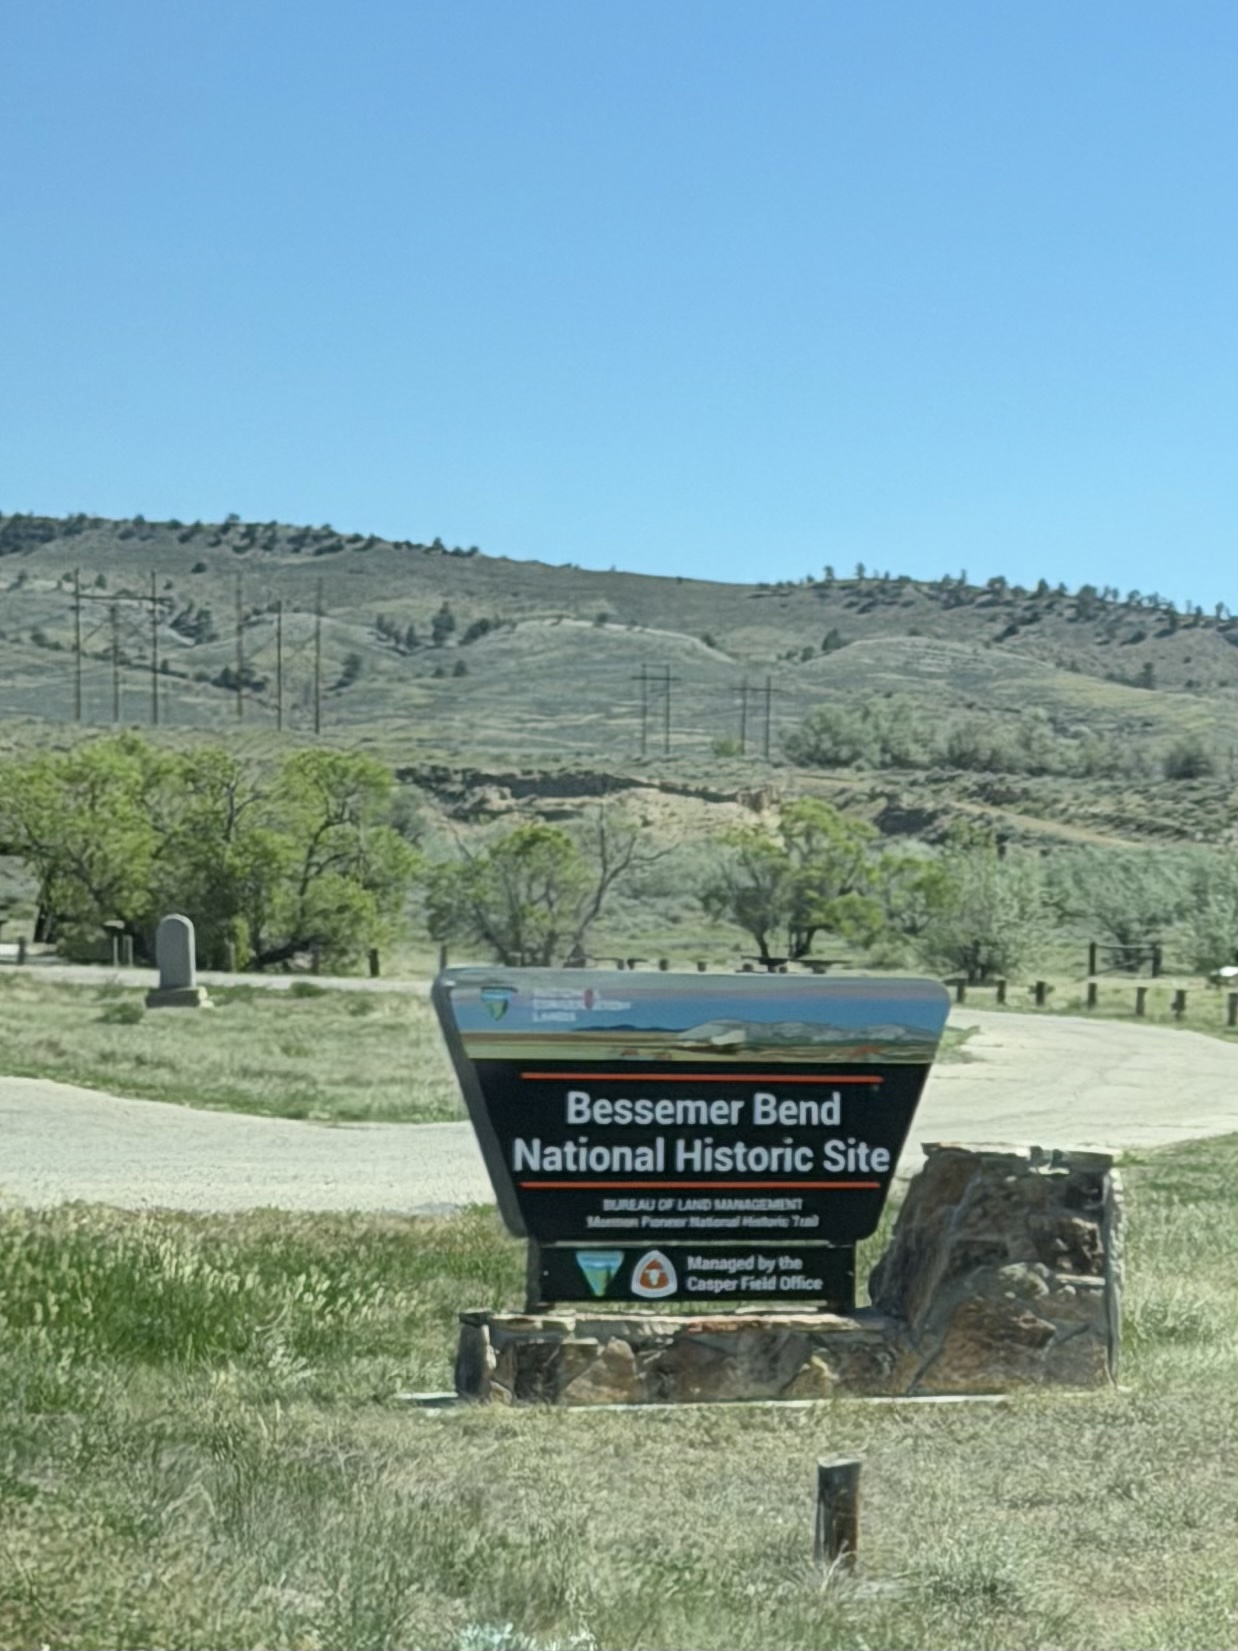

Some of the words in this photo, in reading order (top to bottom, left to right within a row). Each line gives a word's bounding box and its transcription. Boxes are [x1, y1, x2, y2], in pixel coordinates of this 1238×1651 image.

[566, 1091, 744, 1125] Bessemer
[753, 1091, 842, 1126] Bend
[513, 1136, 665, 1172] National
[675, 1137, 814, 1173] Historic
[823, 1138, 891, 1173] Site
[603, 1198, 656, 1211] BUREAU
[657, 1198, 674, 1211] OF
[677, 1198, 712, 1211] LAND
[714, 1198, 803, 1211] MANAGEMENT
[687, 1256, 754, 1273] Managed
[757, 1256, 775, 1273] by
[779, 1256, 803, 1271] the
[687, 1276, 738, 1294] Casper
[741, 1276, 776, 1291] Field
[780, 1276, 823, 1291] Office
